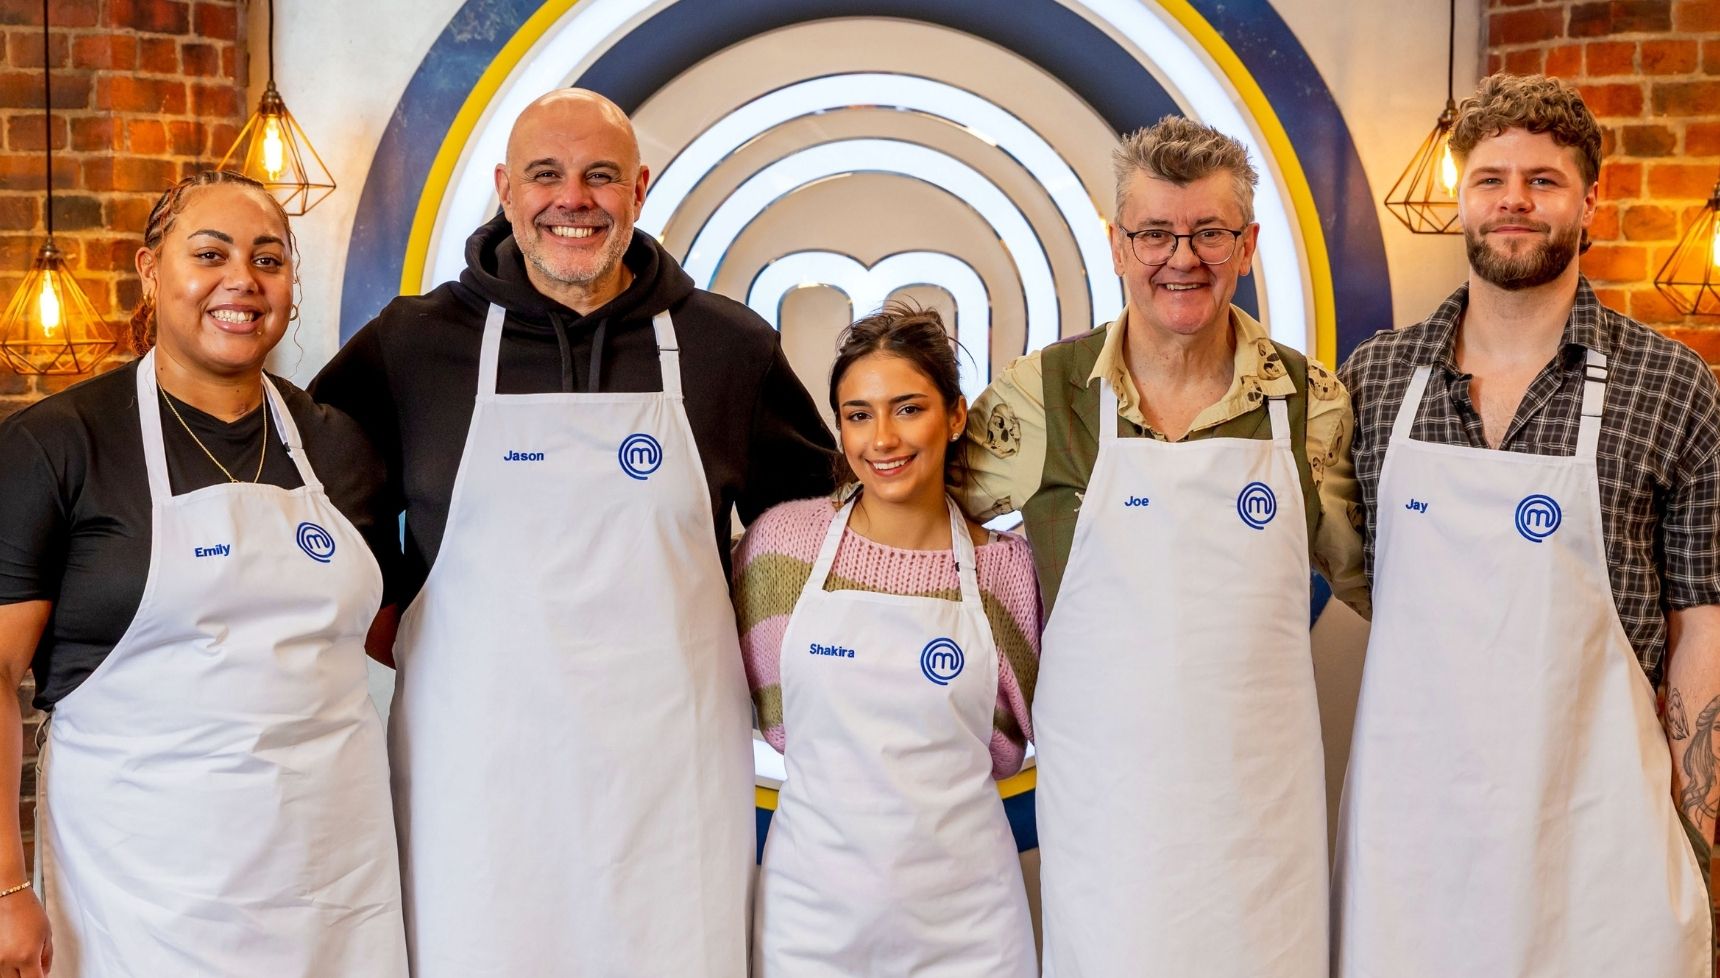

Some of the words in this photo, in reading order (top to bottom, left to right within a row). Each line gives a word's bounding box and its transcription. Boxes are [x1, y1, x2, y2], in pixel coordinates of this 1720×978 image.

[503, 449, 545, 462] Jason
[1124, 495, 1150, 507] Joe
[1405, 498, 1429, 514] Jay
[194, 543, 231, 558] Emily
[809, 642, 855, 659] Shakira
